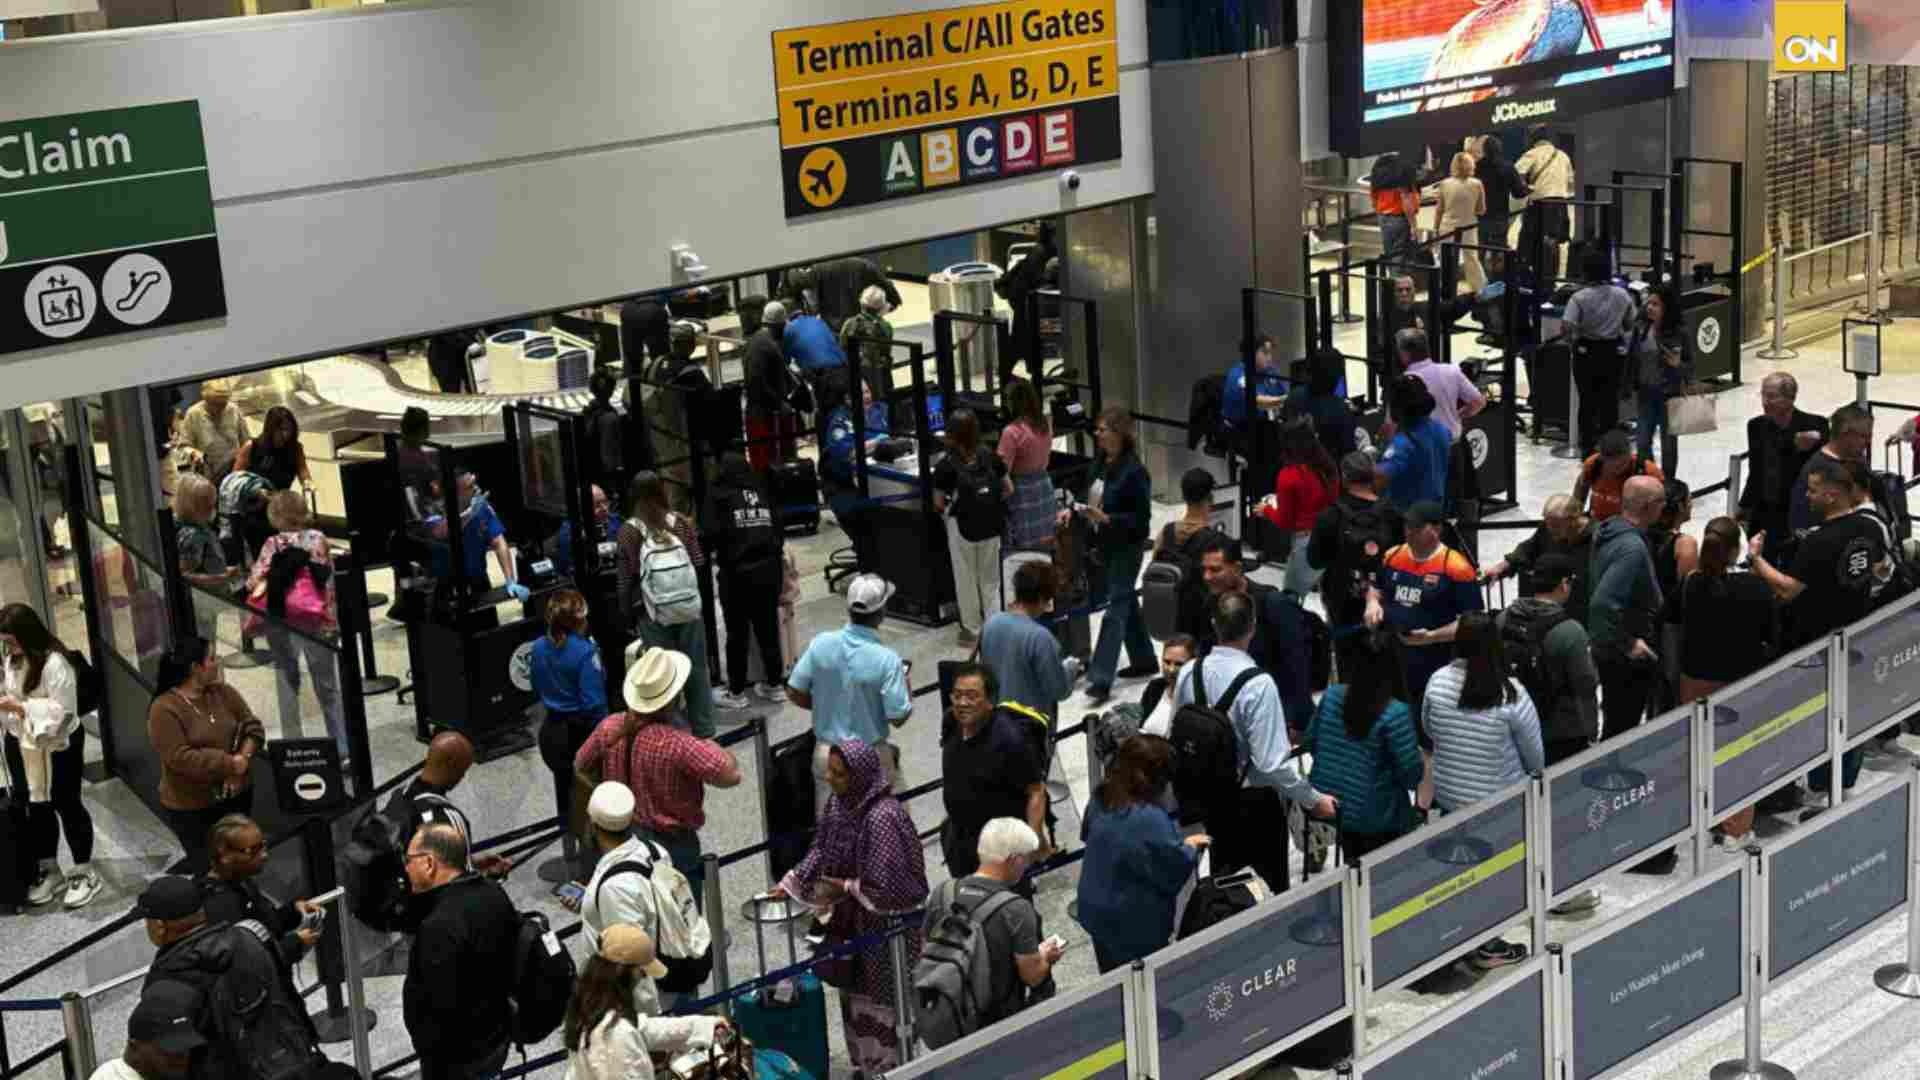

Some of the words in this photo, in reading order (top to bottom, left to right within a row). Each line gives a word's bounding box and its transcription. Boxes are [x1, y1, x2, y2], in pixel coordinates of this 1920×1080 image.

[789, 23, 934, 76] Terminal
[942, 12, 1013, 54] C/All
[1022, 8, 1105, 42] Gates
[1785, 37, 1838, 64] ON
[794, 78, 959, 133] Terminals
[968, 74, 1000, 108] A,
[1009, 67, 1038, 102] B,
[1048, 62, 1078, 96] D,
[1087, 56, 1105, 87] E
[1492, 99, 1557, 124] JCDecaux
[0, 127, 133, 179] Claim
[885, 140, 916, 181] A
[927, 132, 954, 173] B
[966, 126, 994, 166] C
[1005, 121, 1033, 160] D
[1045, 113, 1069, 153] E
[1893, 643, 1920, 668] CLEA
[1613, 780, 1656, 810] CLEAR
[1241, 958, 1297, 997] CLEAR
